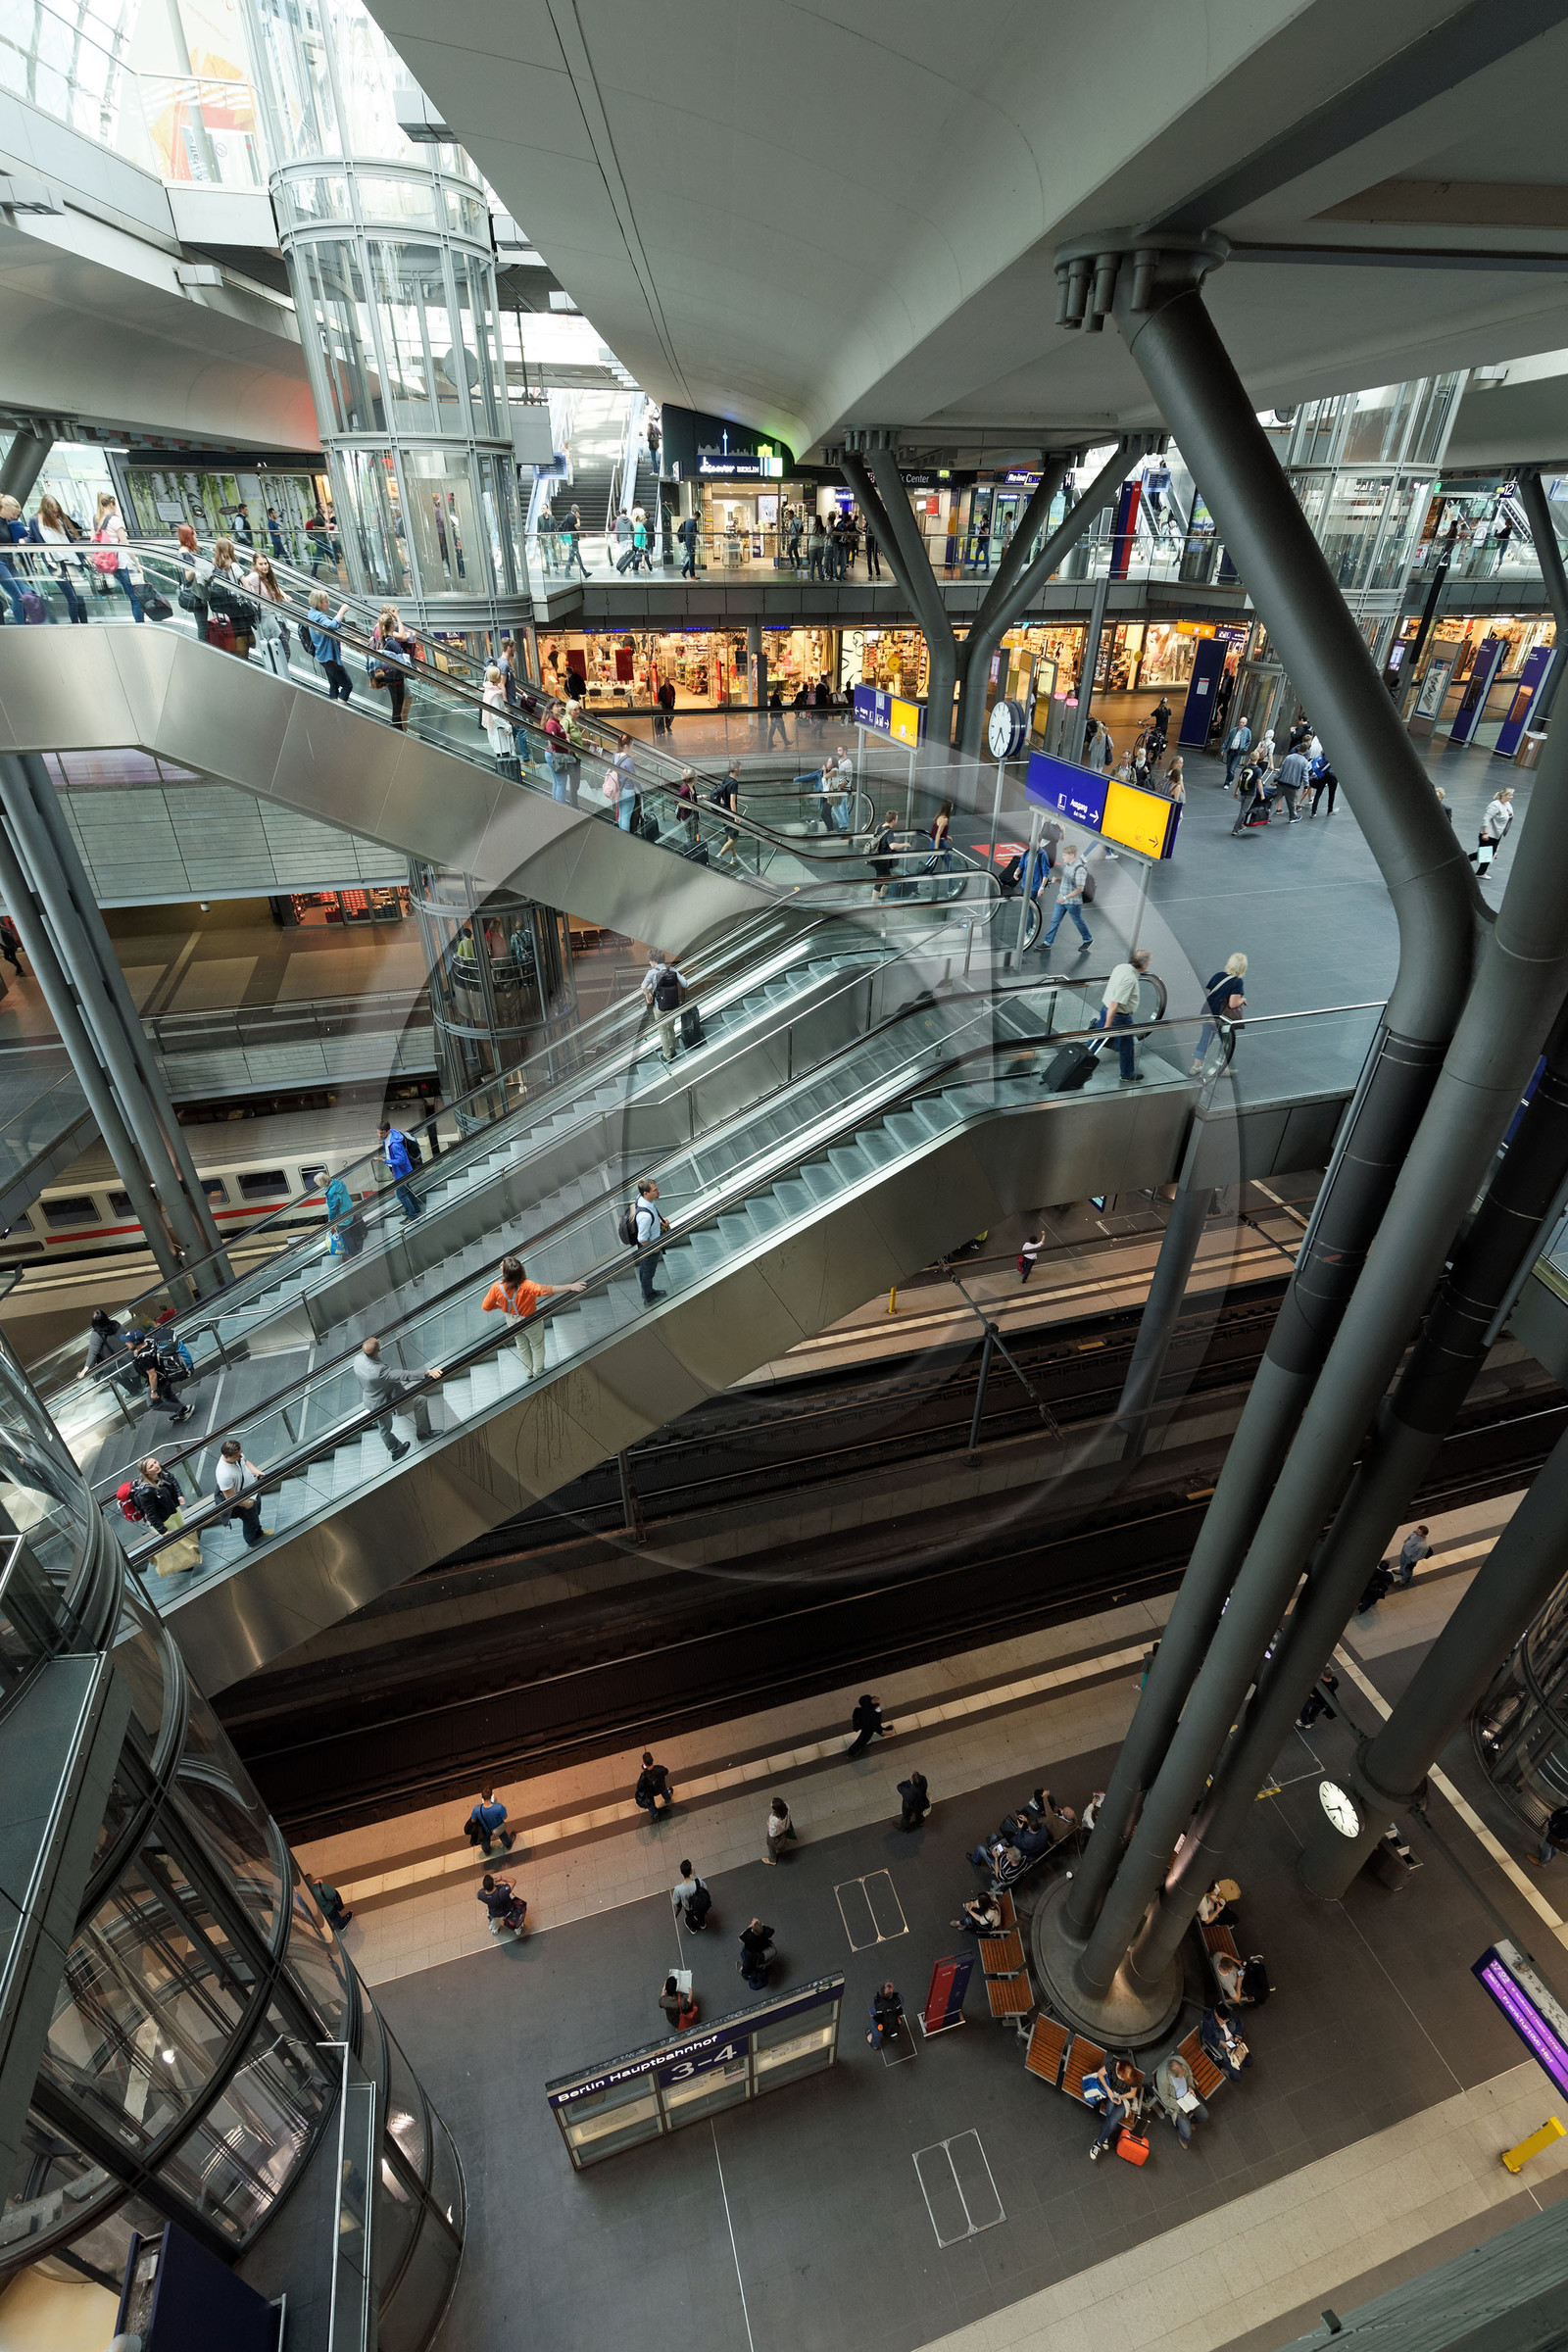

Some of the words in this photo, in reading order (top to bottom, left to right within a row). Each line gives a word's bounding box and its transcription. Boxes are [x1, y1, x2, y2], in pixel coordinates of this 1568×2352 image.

[906, 473, 930, 483] Center
[1064, 473, 1072, 487] 14
[1503, 483, 1515, 495] 12
[558, 2080, 606, 2102] Berlin
[610, 2034, 718, 2082] Hauptbahnhof
